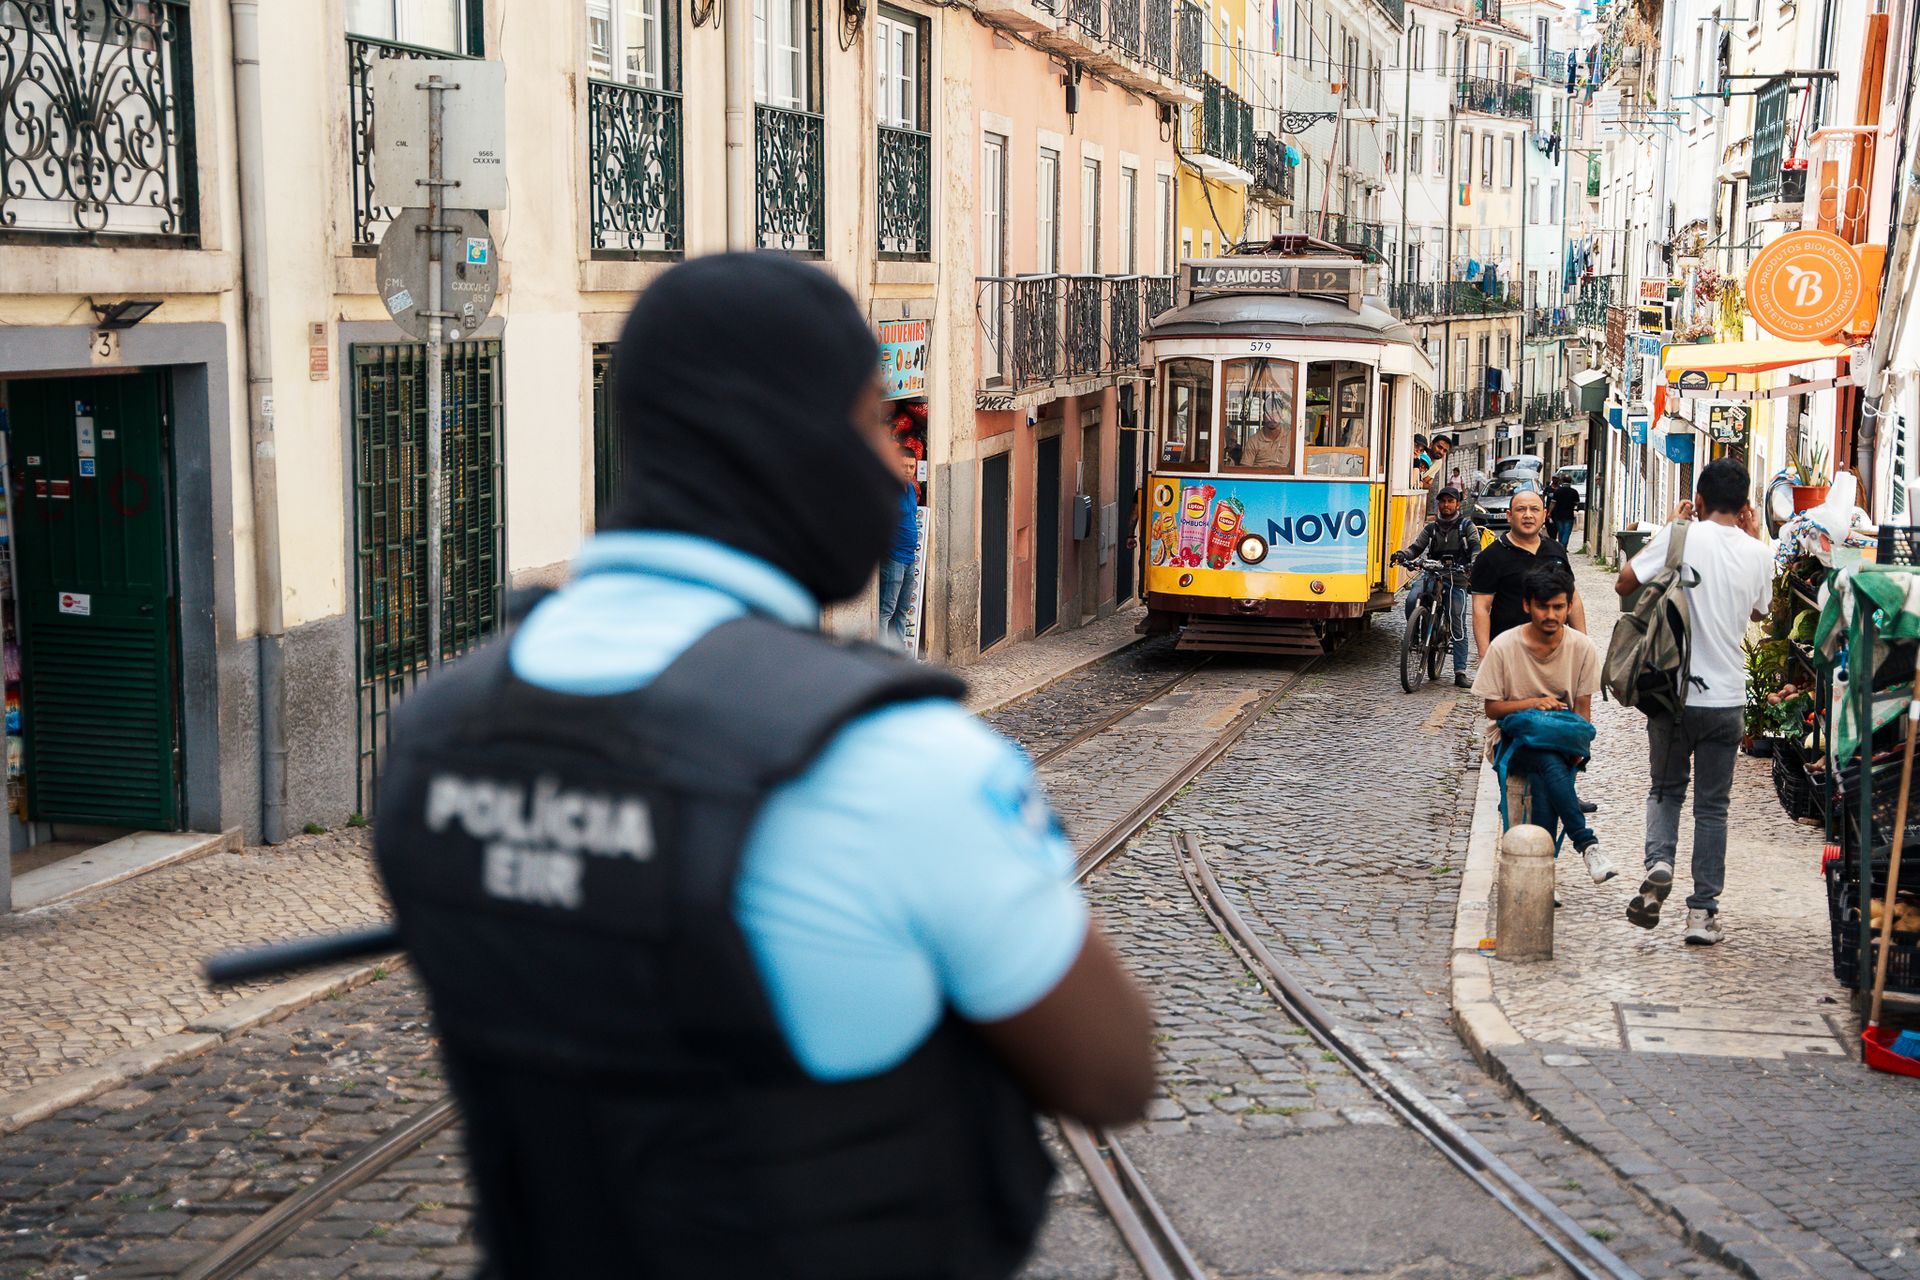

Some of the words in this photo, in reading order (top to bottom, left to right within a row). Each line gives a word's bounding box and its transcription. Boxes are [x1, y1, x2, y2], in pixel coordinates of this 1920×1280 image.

[1761, 242, 1801, 285] PRODUTOS
[385, 278, 405, 288] CML
[1312, 272, 1337, 290] 12
[1815, 288, 1853, 328] NATURAIS
[878, 322, 925, 345] SOUVENIRS
[98, 332, 111, 357] 3
[1250, 341, 1272, 352] 579
[1188, 503, 1204, 511] Lipton
[1219, 517, 1235, 525] Lipton
[1267, 508, 1367, 547] NOVO
